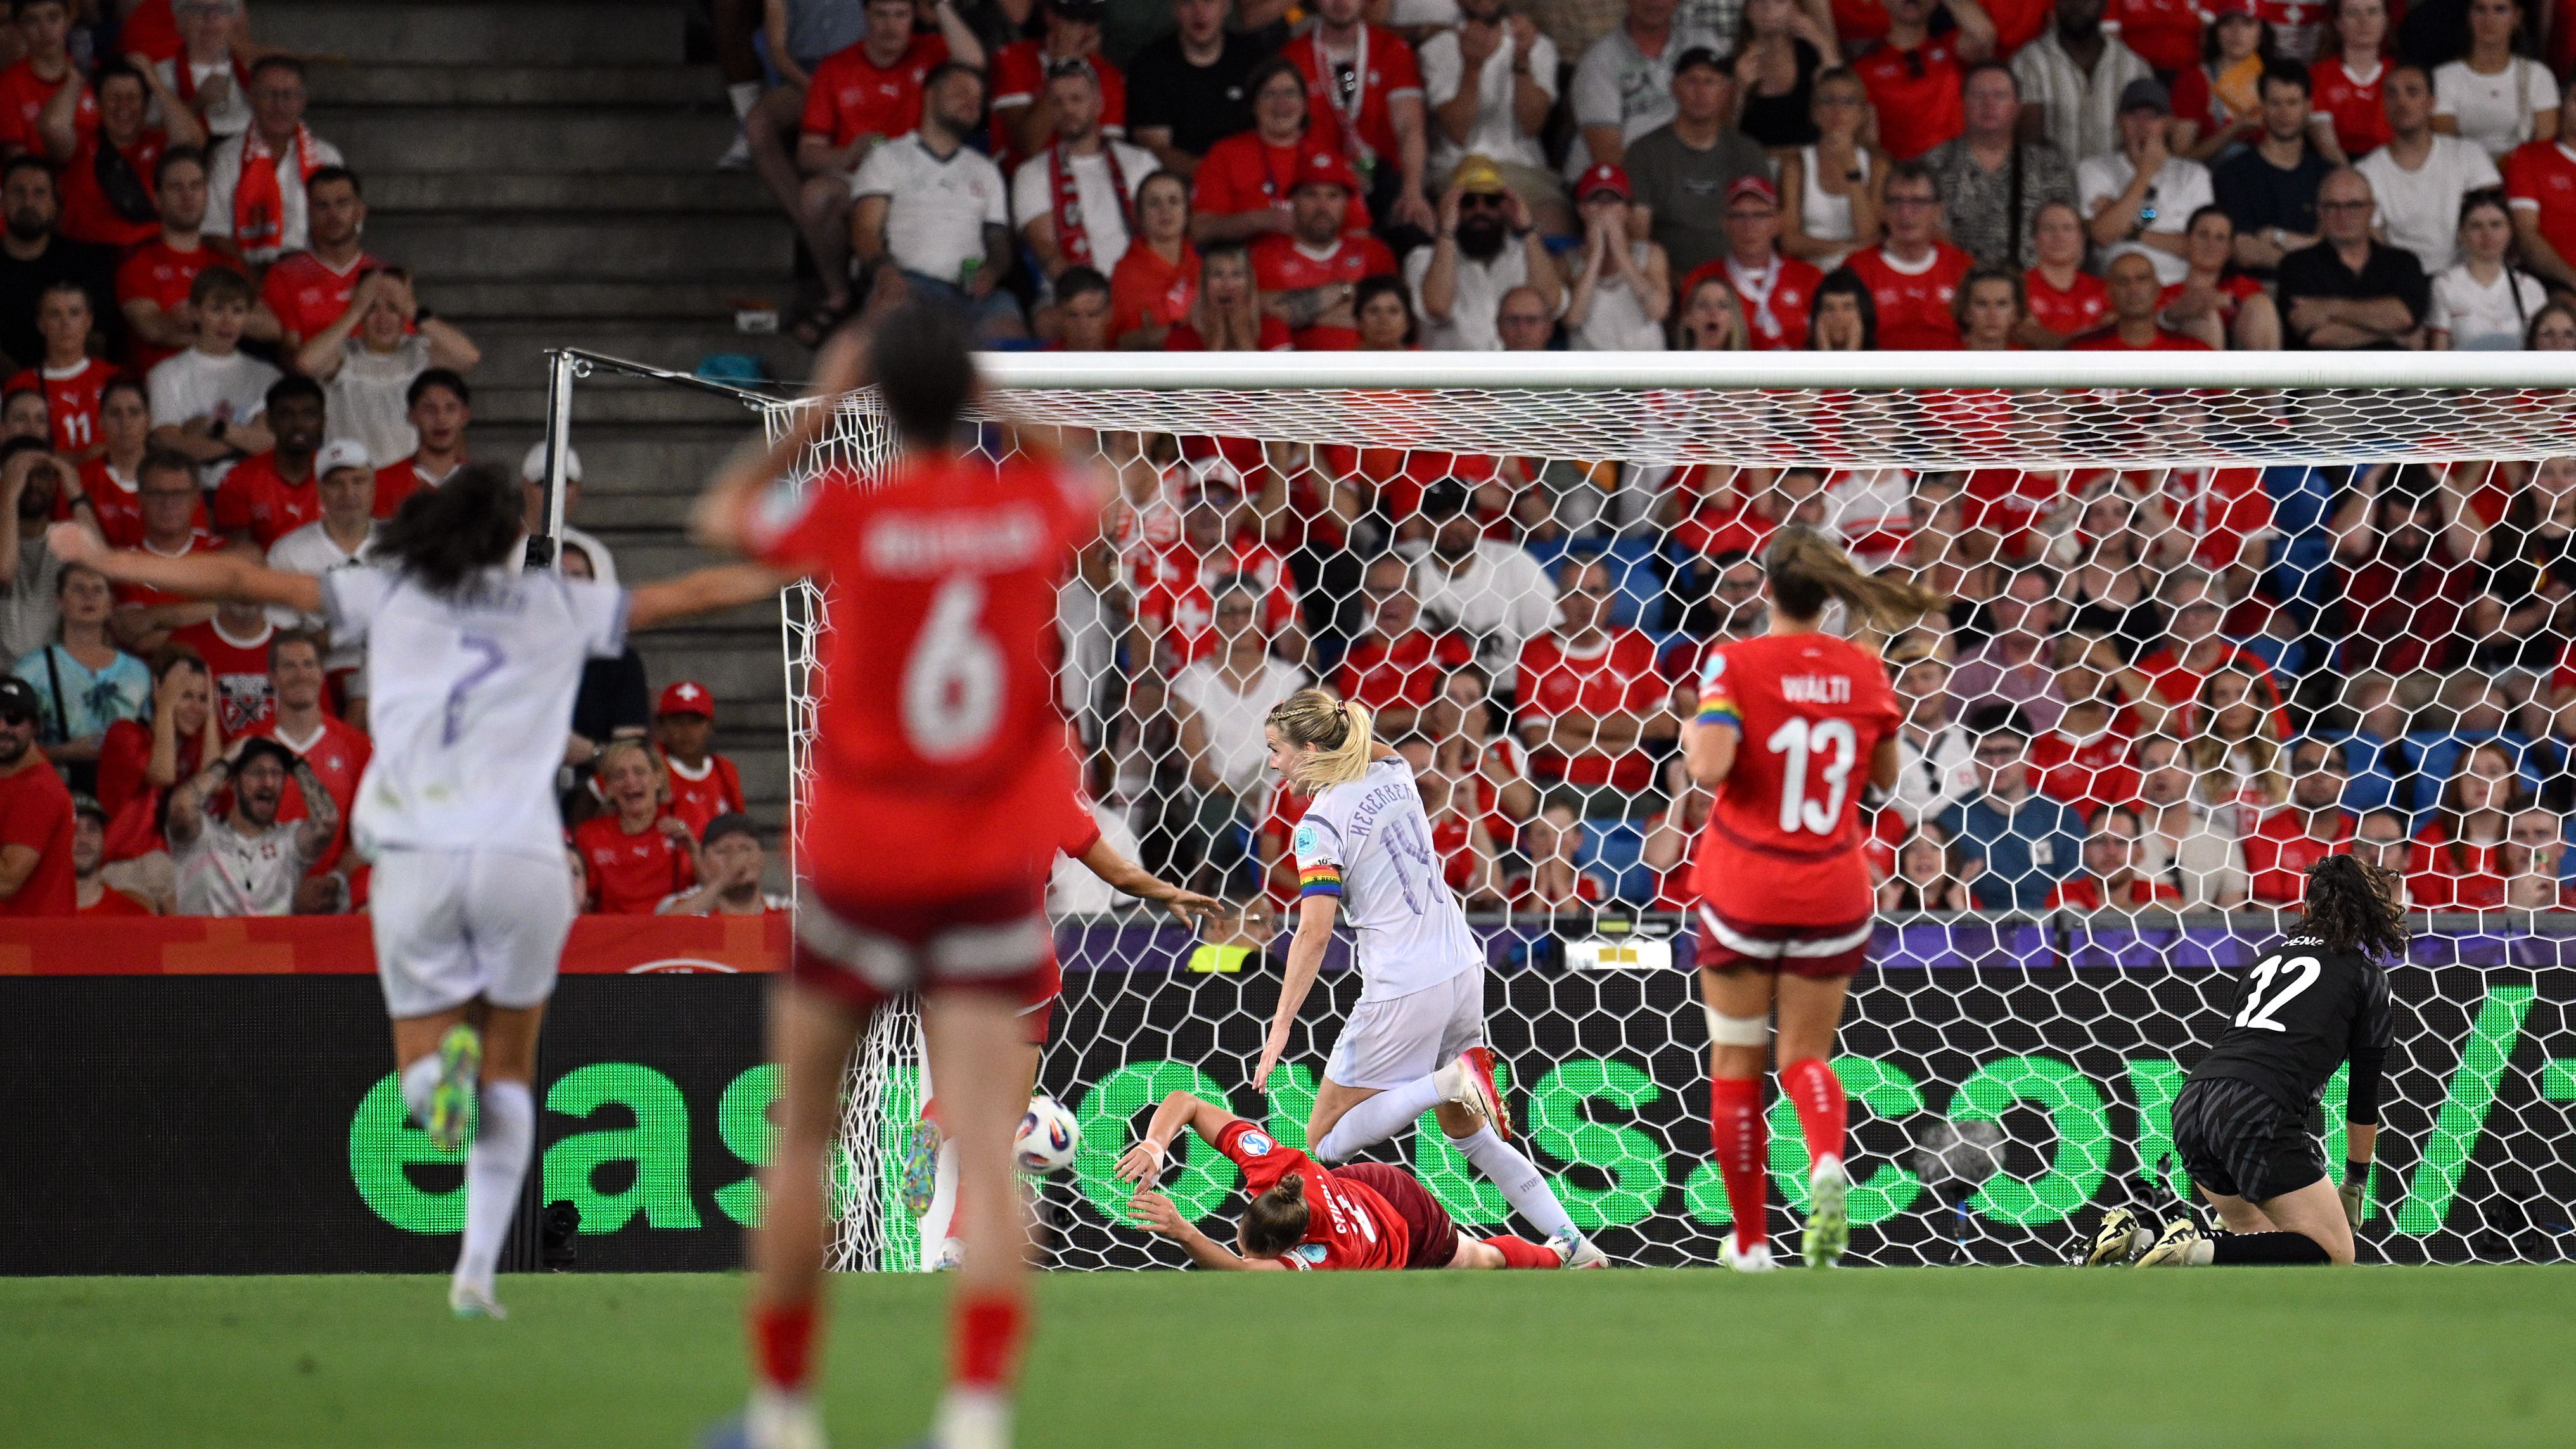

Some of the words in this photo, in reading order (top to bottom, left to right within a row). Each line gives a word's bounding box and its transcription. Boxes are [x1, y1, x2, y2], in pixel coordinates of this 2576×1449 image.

[63, 412, 91, 447] 11
[444, 632, 509, 748] 7
[901, 578, 1008, 764] 6
[1350, 783, 1421, 837] HEGERBER
[1767, 717, 1856, 836] 13
[1379, 810, 1444, 916] 14
[2234, 954, 2321, 1033] 12
